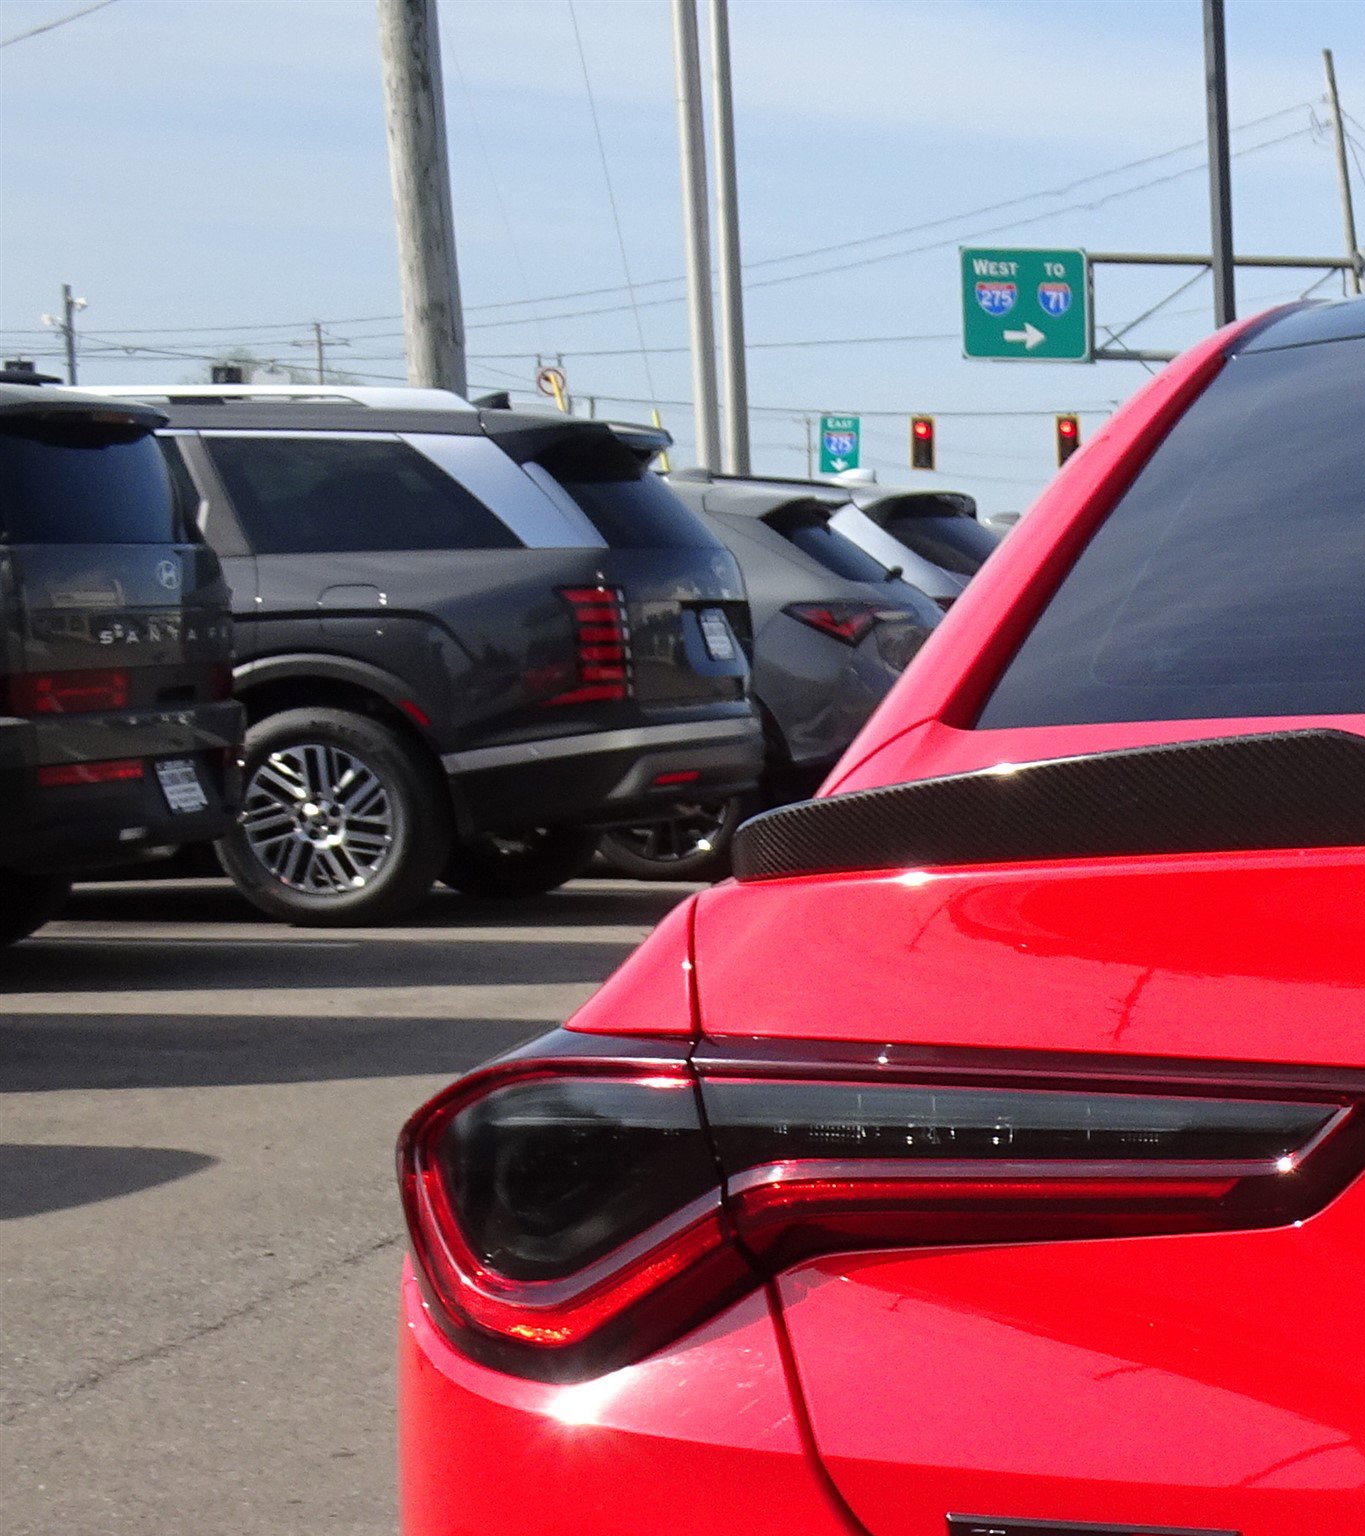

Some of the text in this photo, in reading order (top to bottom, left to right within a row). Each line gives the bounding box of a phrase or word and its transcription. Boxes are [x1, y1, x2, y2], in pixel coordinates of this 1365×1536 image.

[973, 258, 1018, 276] WEST
[1043, 262, 1065, 278] TO
[981, 291, 1012, 307] 275
[1048, 292, 1065, 310] 71
[100, 625, 197, 644] SANTA
